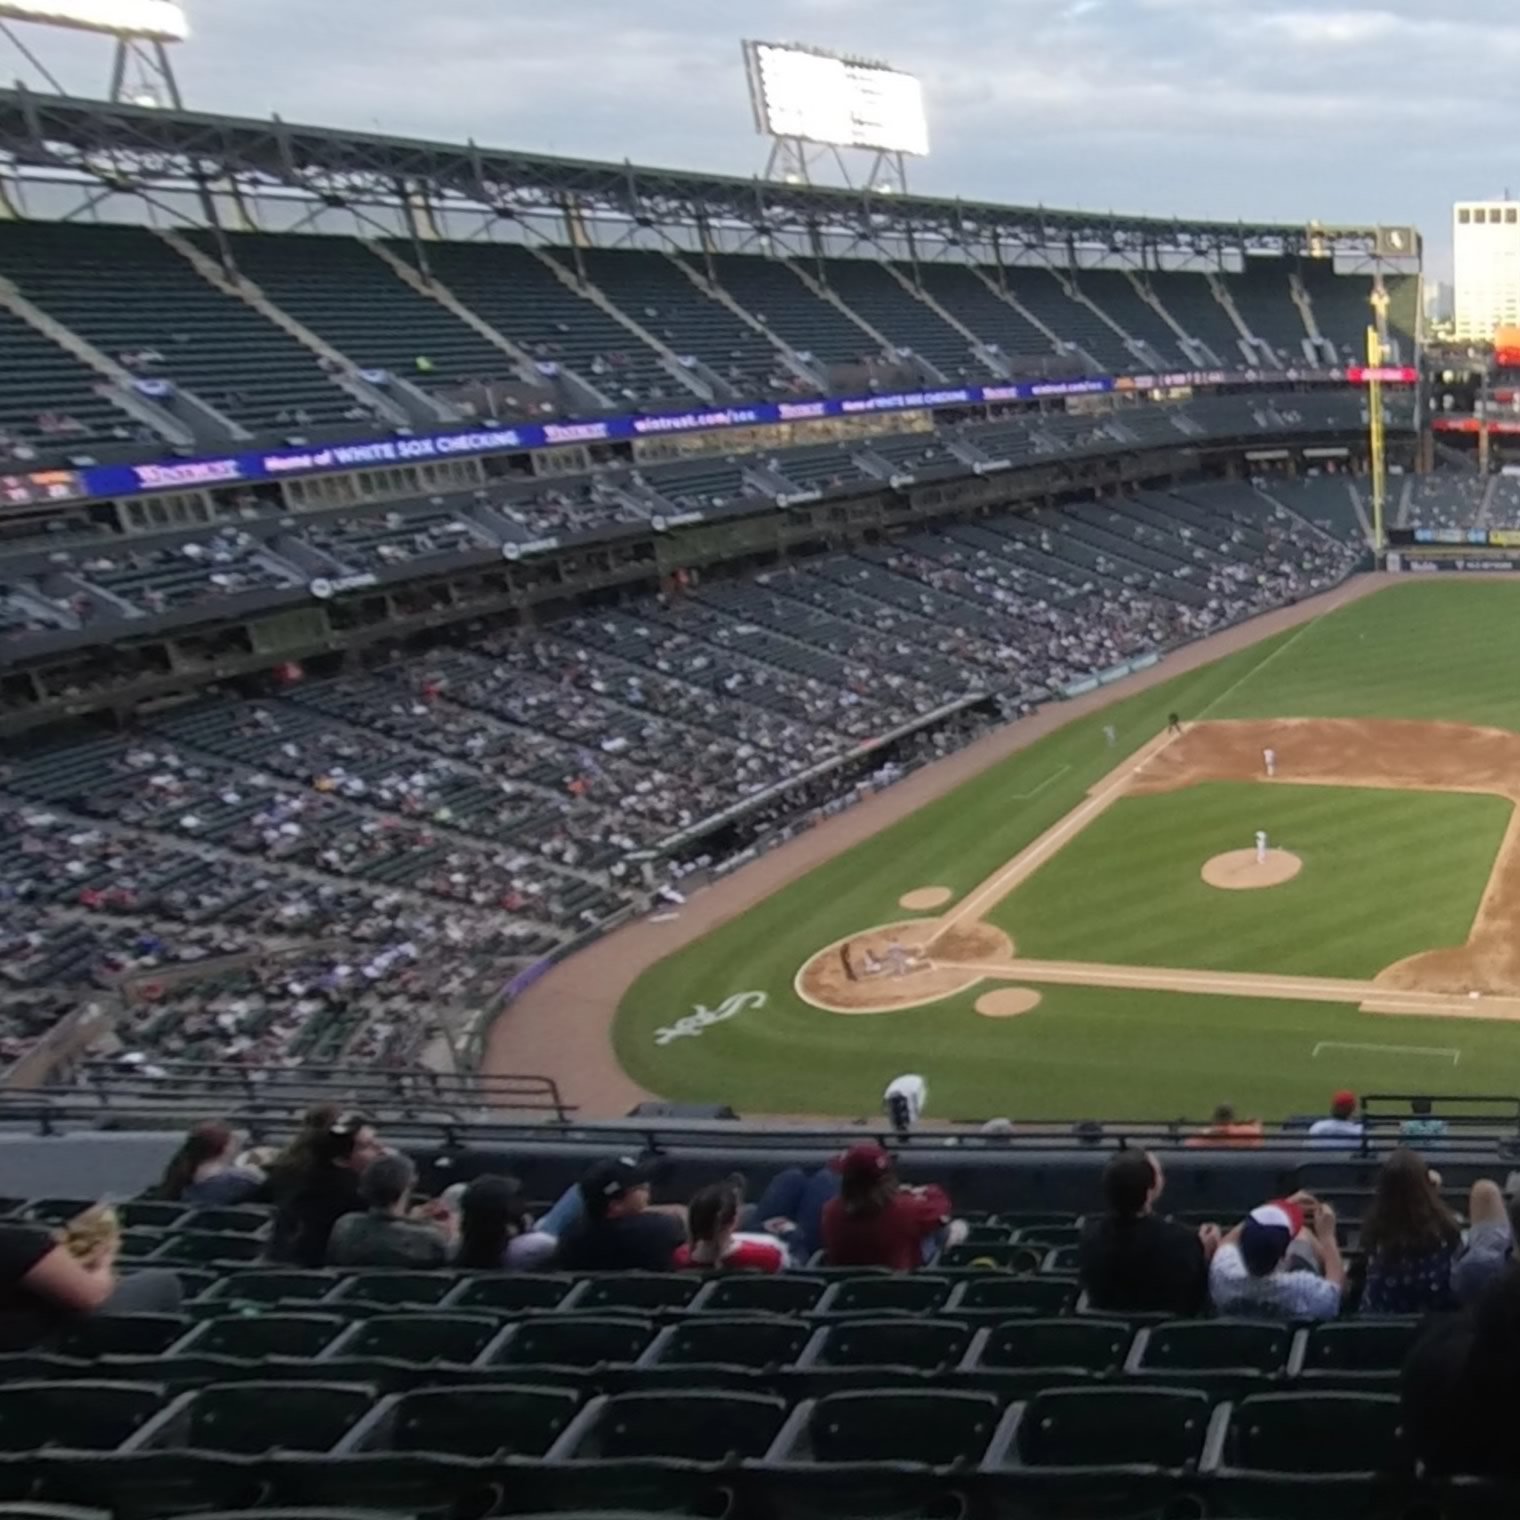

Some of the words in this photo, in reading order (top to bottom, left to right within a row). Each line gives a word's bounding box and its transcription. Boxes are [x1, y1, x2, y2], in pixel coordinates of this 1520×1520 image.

[634, 410, 755, 432] wintrust.com/sox
[333, 442, 395, 464] WHITE
[397, 438, 435, 458] SOX
[436, 430, 520, 453] CHECKING
